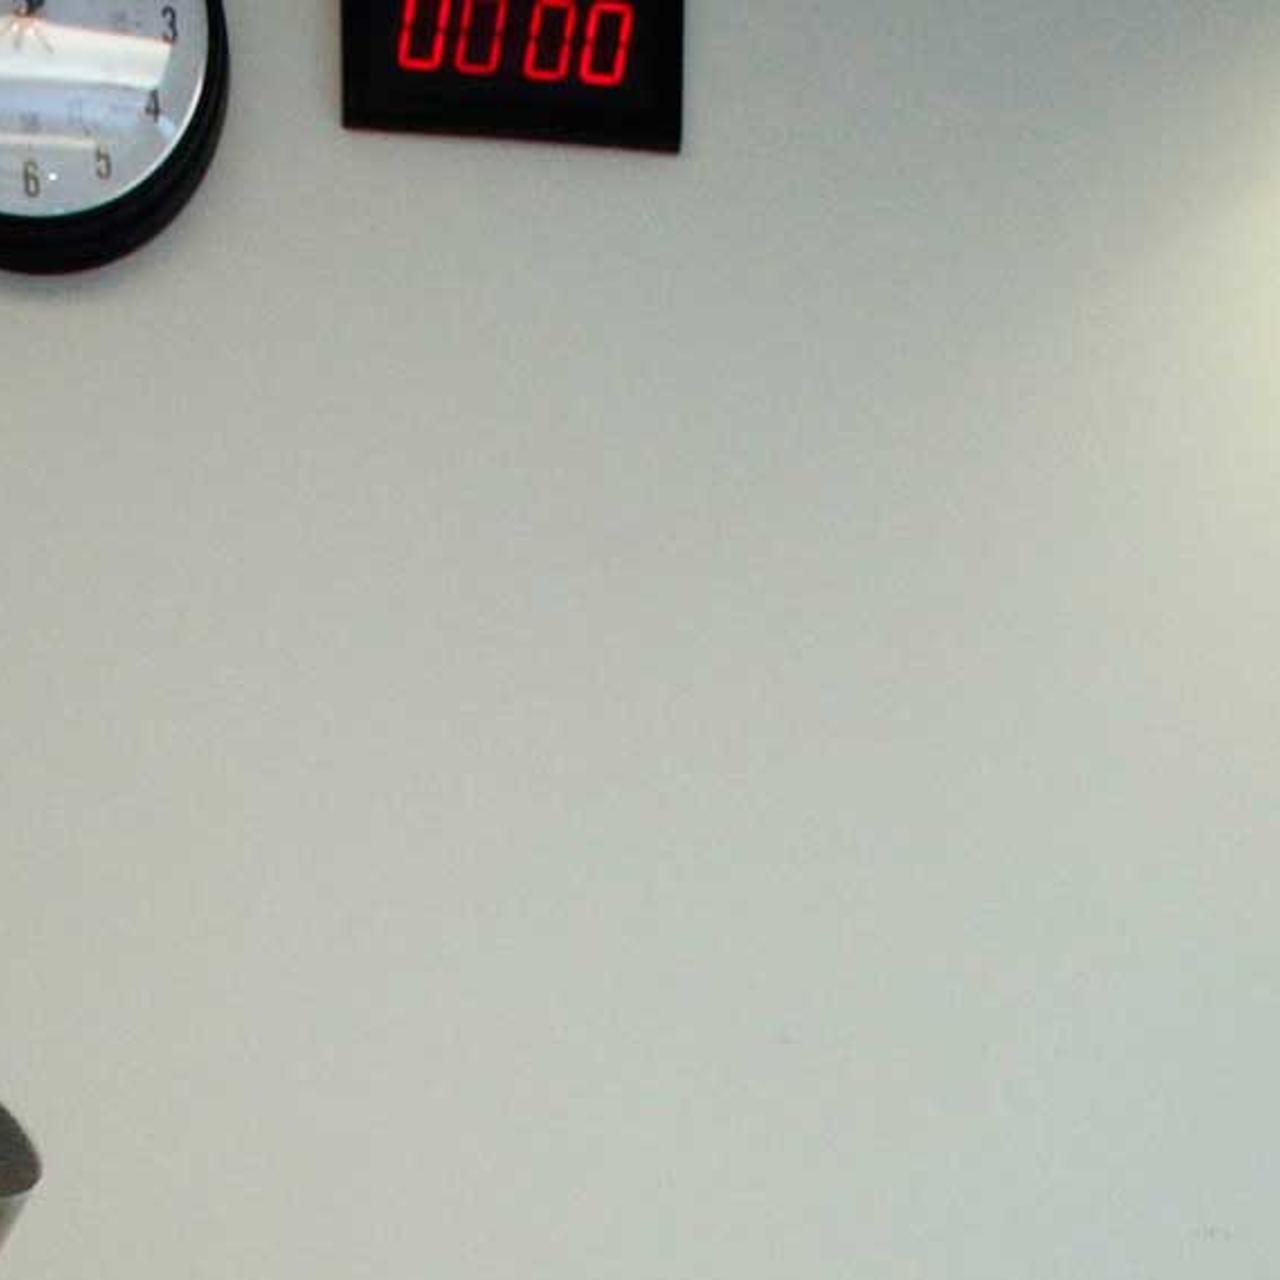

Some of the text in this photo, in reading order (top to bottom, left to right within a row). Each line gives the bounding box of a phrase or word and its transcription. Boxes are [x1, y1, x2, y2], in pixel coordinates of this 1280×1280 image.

[161, 5, 178, 44] 3
[144, 88, 161, 123] 4
[23, 159, 40, 198] 6
[95, 144, 112, 180] 5
